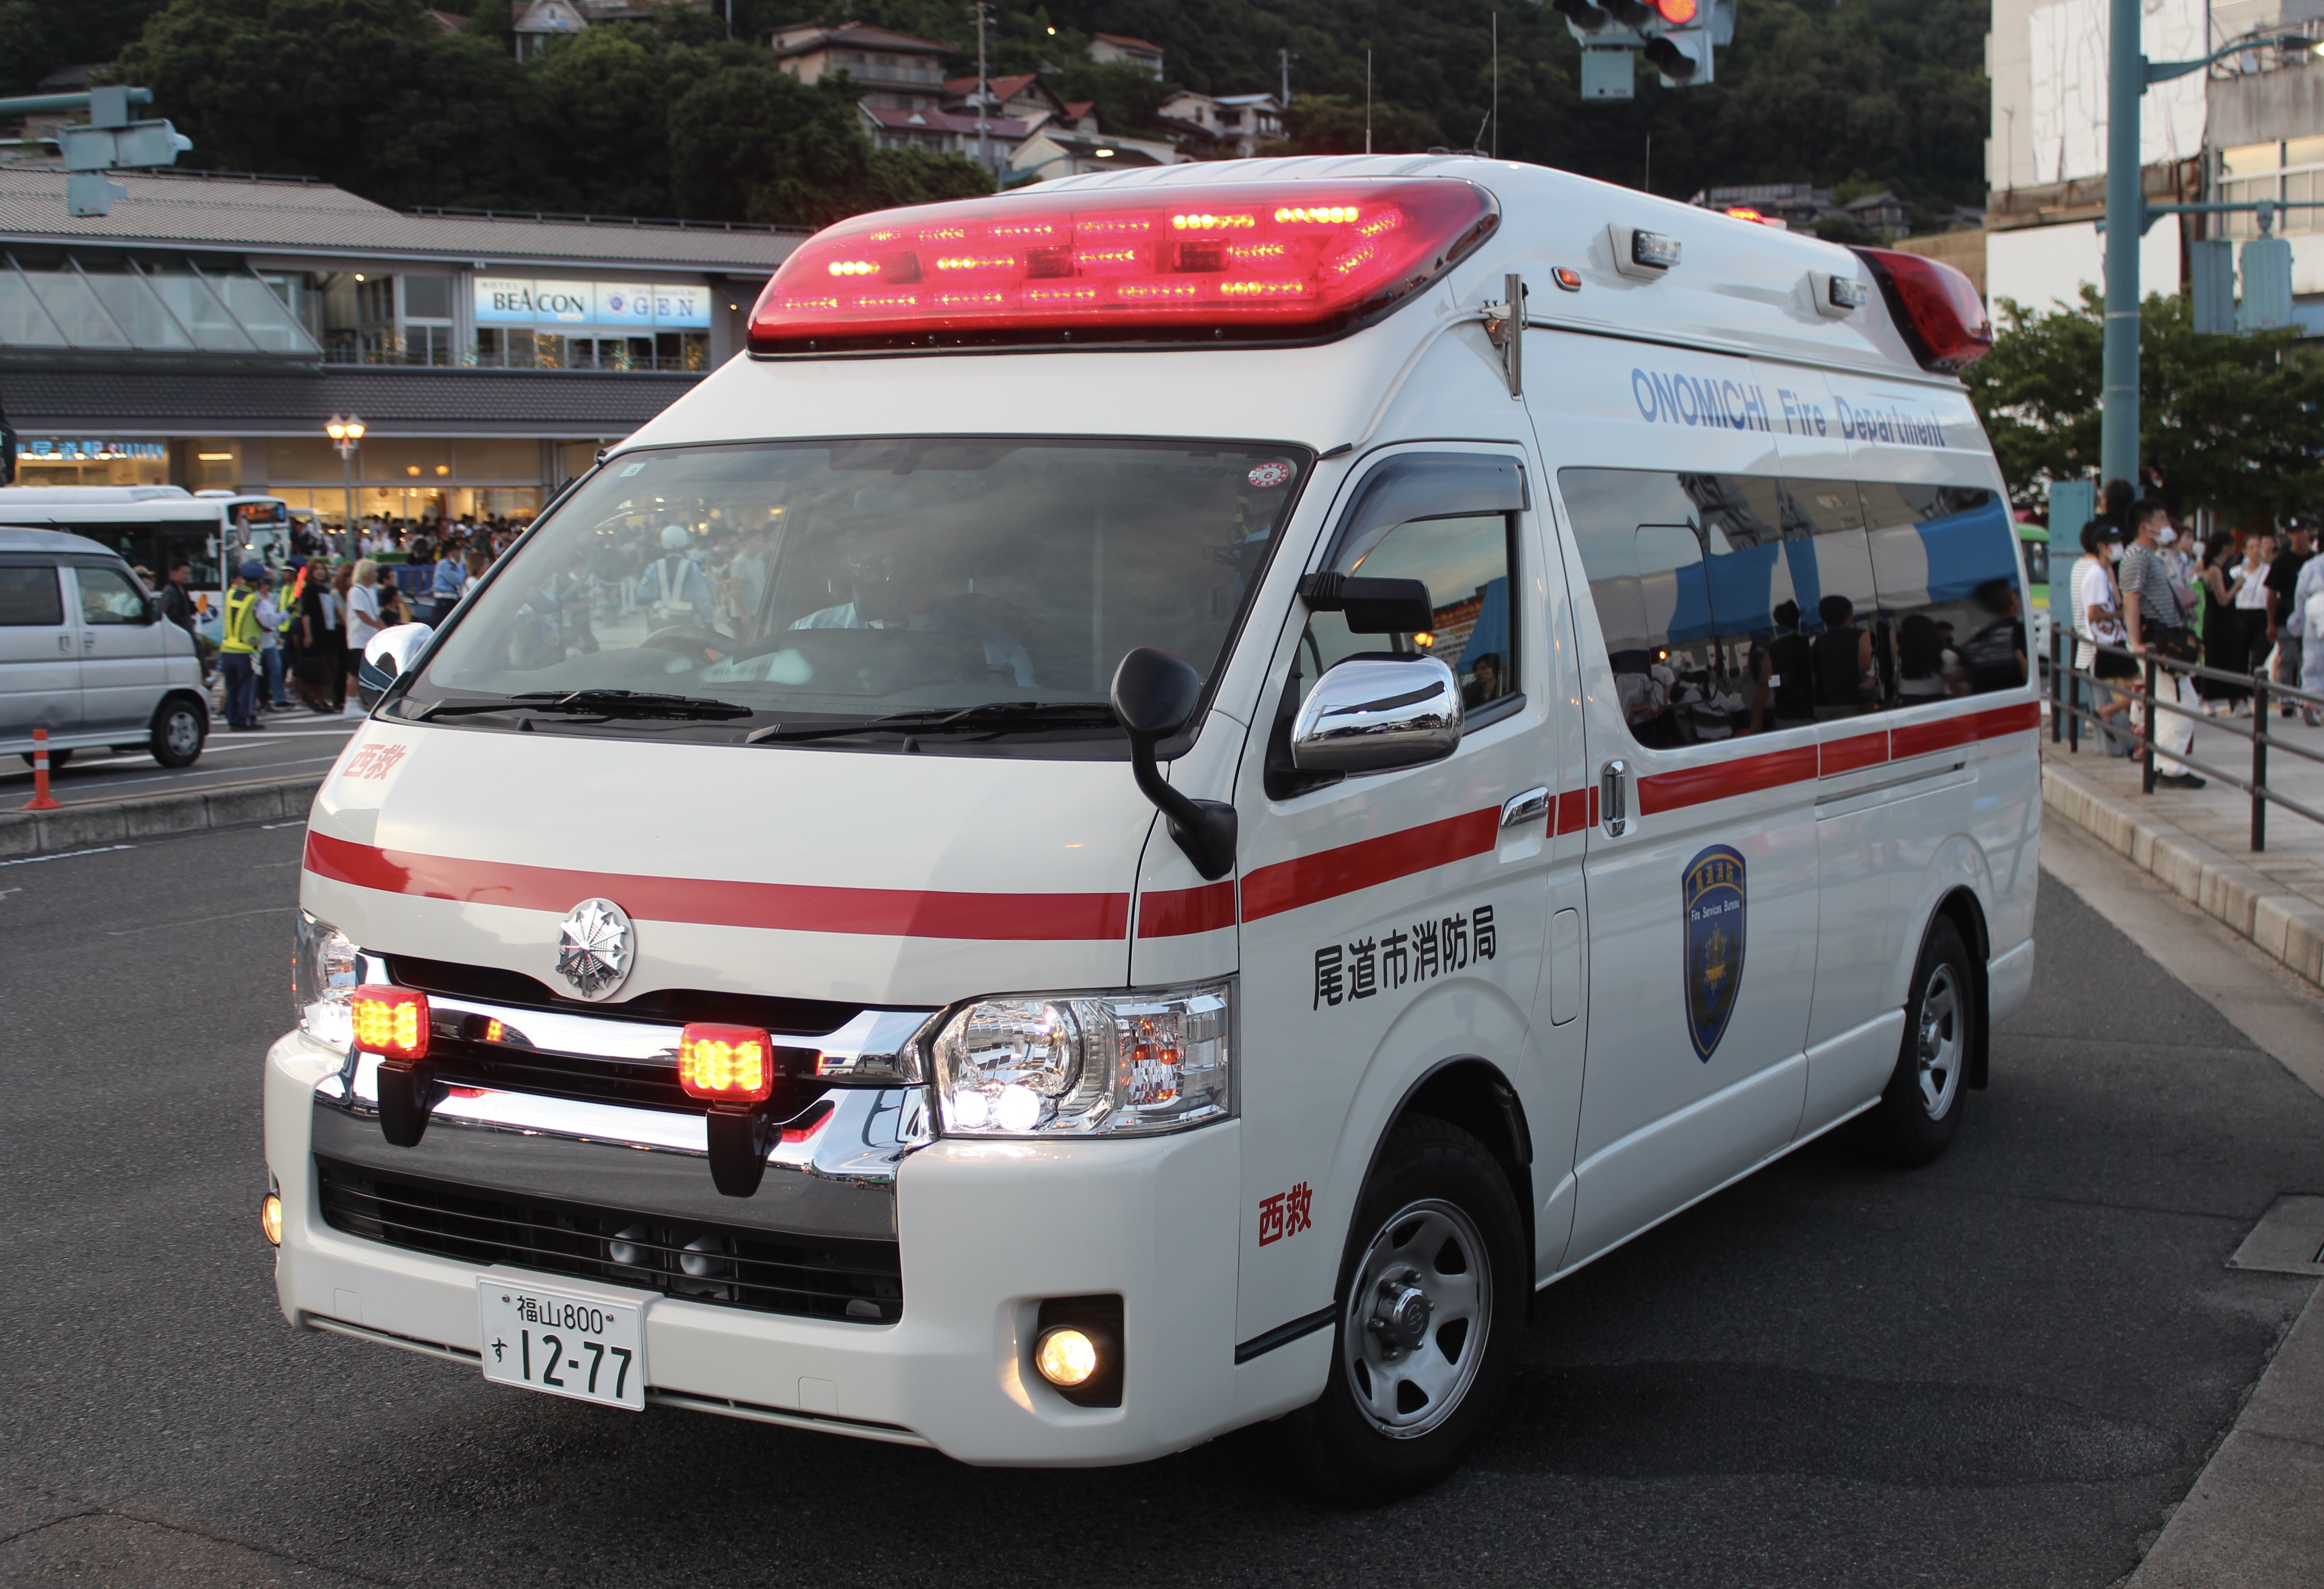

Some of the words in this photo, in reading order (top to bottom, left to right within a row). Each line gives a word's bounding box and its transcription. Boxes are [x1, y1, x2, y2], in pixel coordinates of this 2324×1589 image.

[494, 287, 584, 313] BEACON
[633, 296, 694, 317] GEN
[1632, 367, 1771, 432] ONOMICHI
[1777, 388, 1827, 437] Fire
[1834, 395, 1946, 447] Department
[342, 744, 407, 781] 西救
[1696, 862, 1734, 892] 尾道消防
[1691, 910, 1701, 922] Fire
[1703, 905, 1722, 919] Services
[1724, 900, 1740, 912] Bureau
[1313, 905, 1496, 1011] 尾道市消防局
[1259, 1181, 1312, 1247] 西救
[491, 1336, 508, 1363] す
[522, 1329, 632, 1398] 12-77
